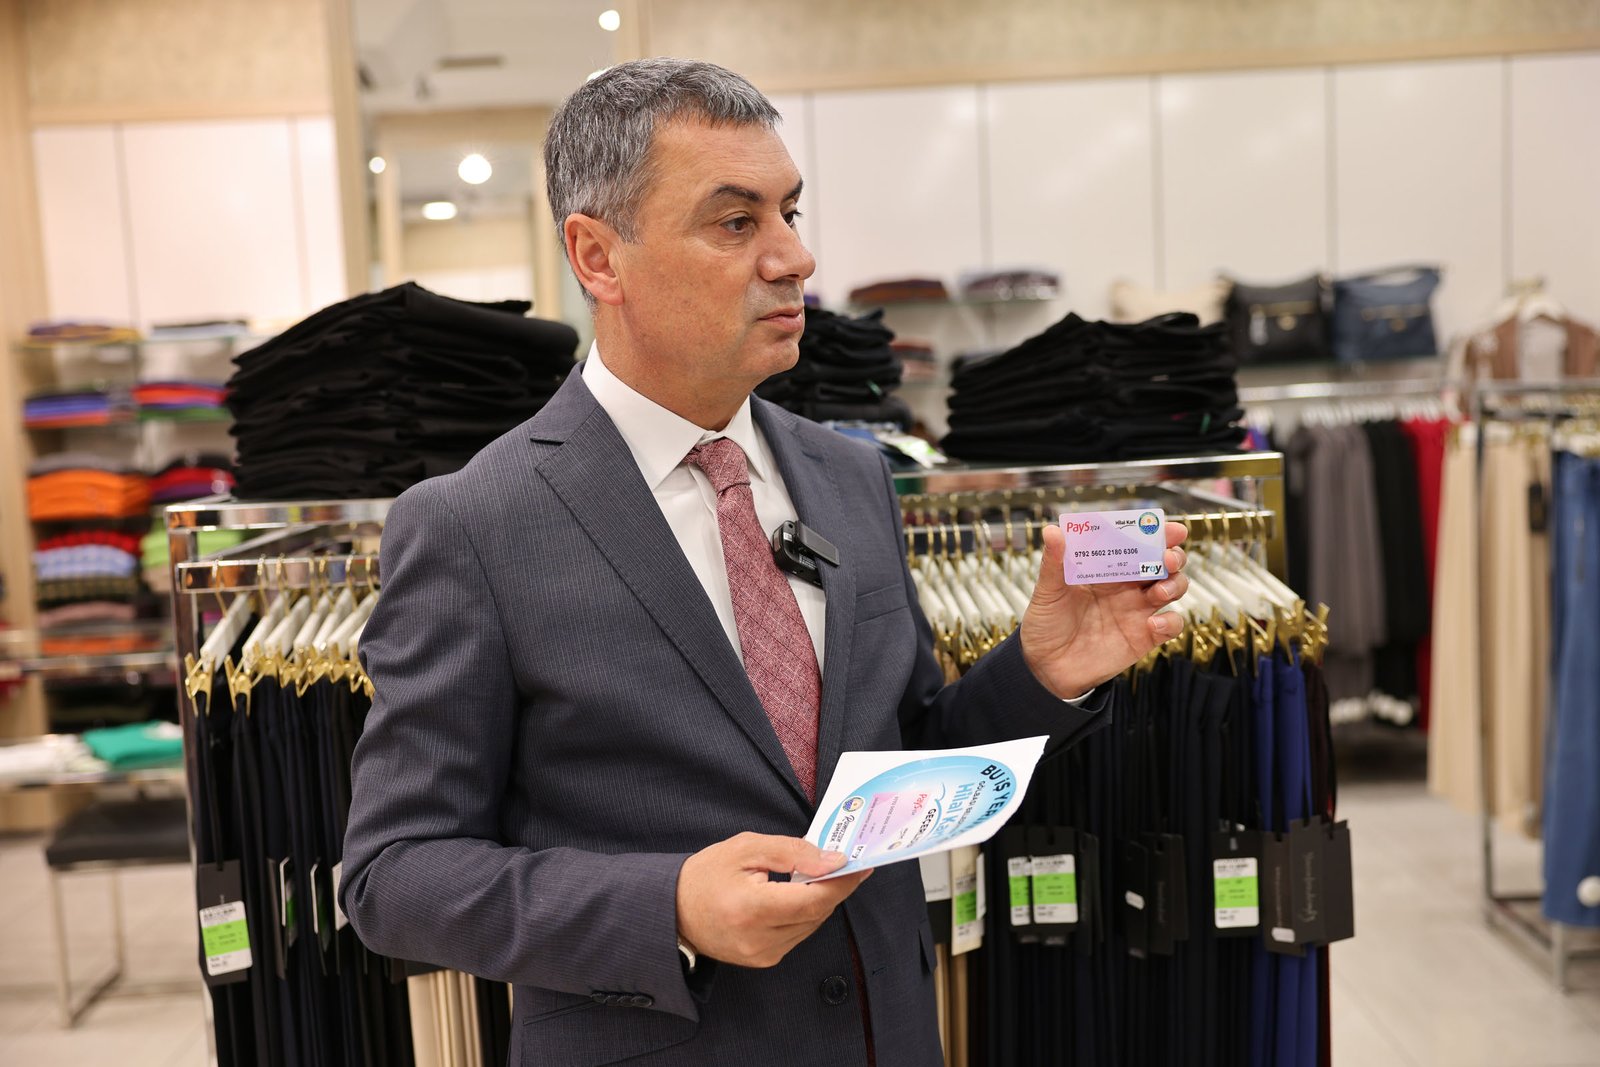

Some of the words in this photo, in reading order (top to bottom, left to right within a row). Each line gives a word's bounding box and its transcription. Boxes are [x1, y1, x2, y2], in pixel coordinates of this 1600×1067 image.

[1066, 521, 1090, 535] PayS
[1091, 549, 1106, 557] 5602
[1107, 548, 1122, 556] 2180
[1123, 547, 1138, 555] 6306
[1141, 564, 1162, 574] troy
[980, 764, 1005, 780] BU
[946, 783, 975, 814] Hilal
